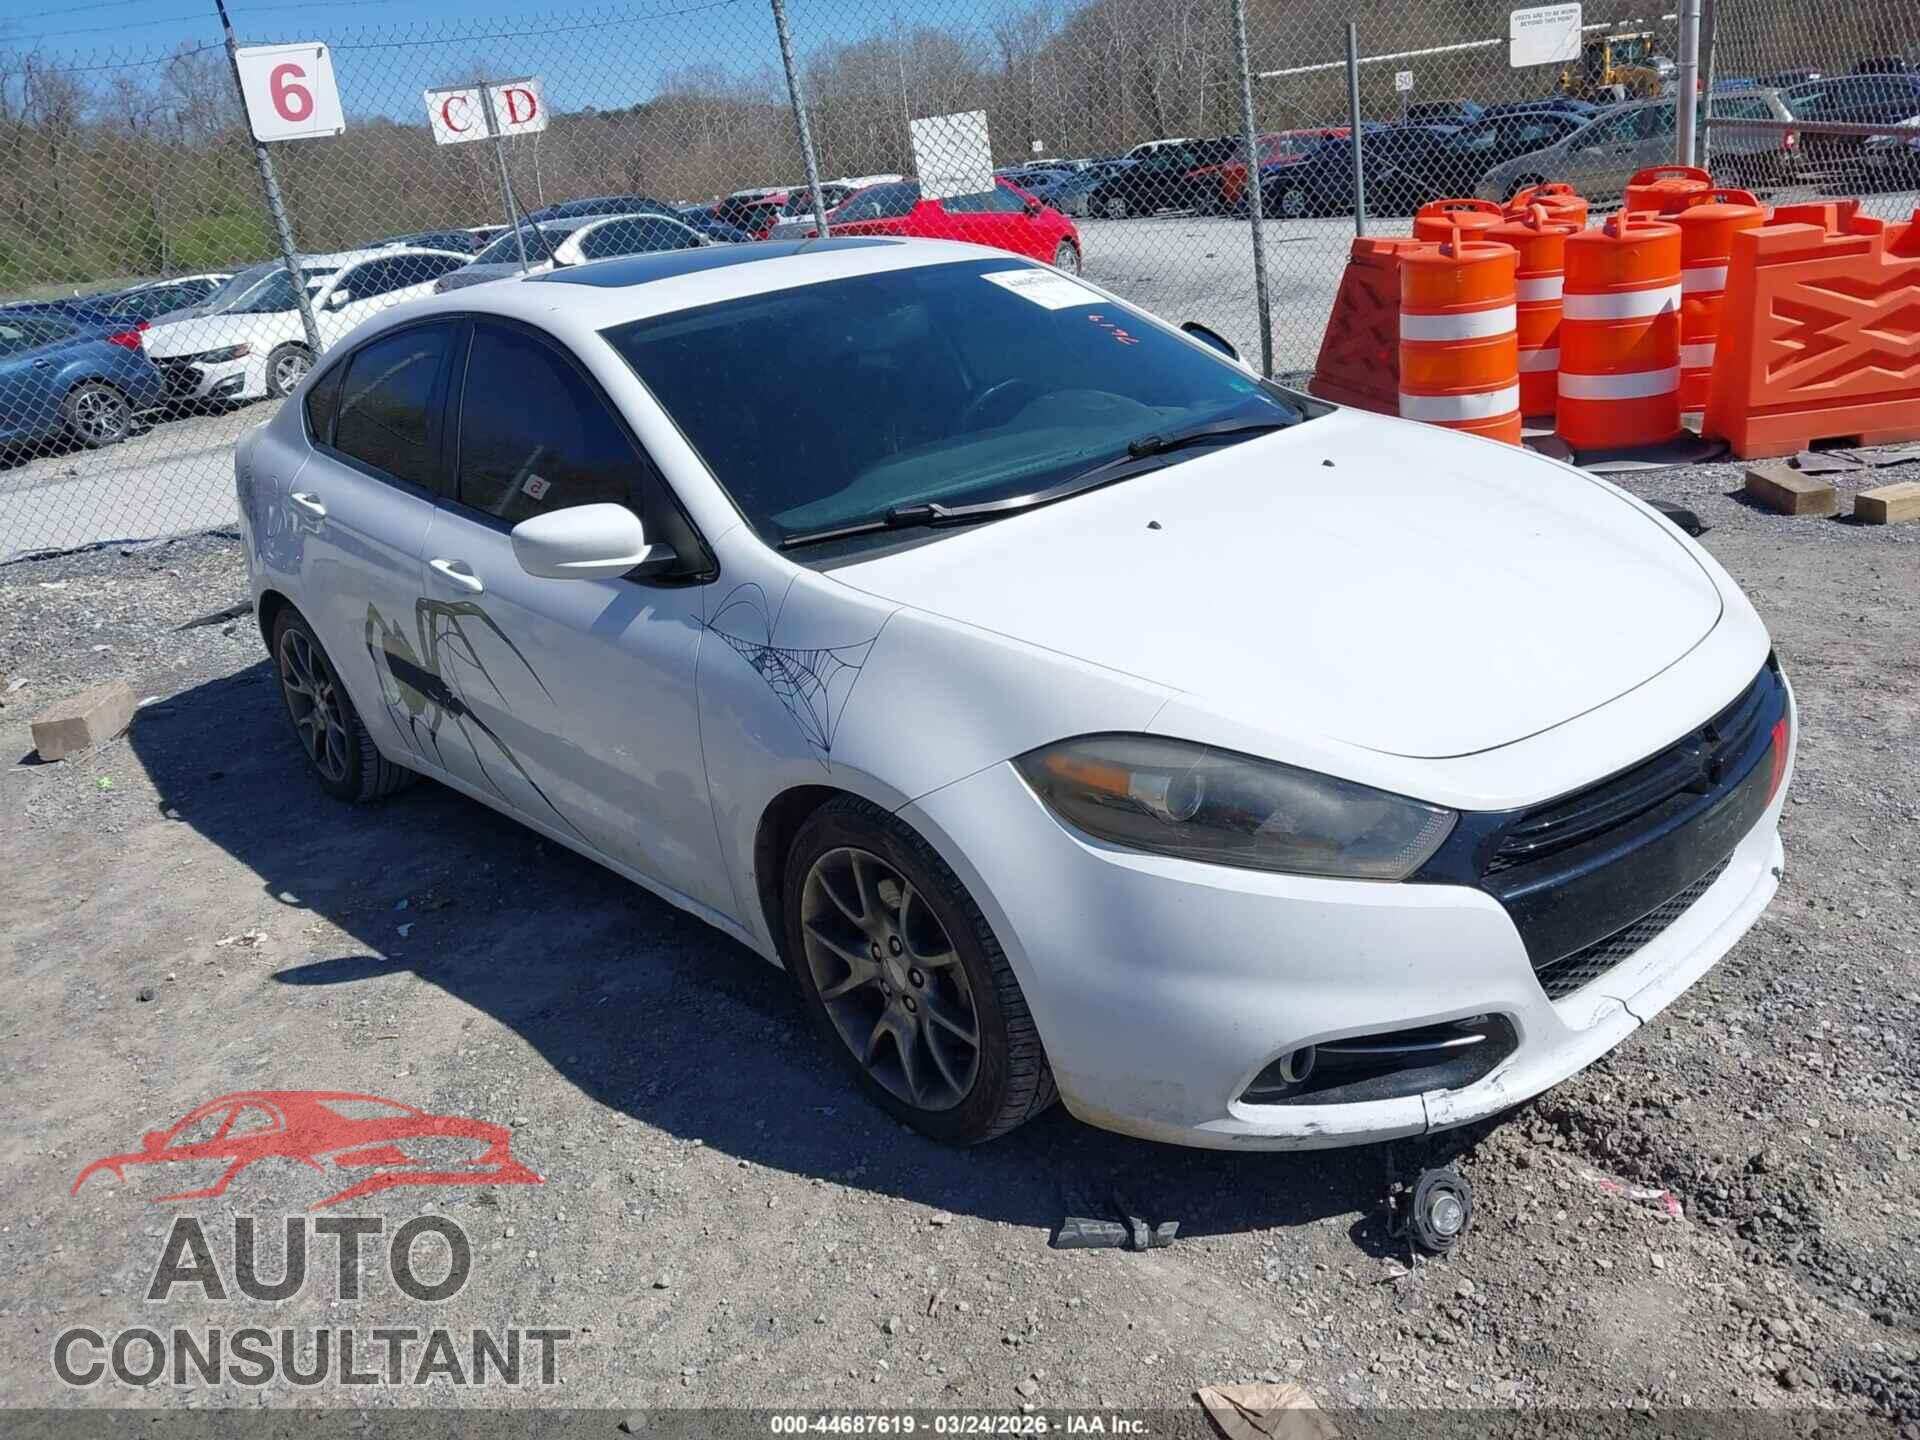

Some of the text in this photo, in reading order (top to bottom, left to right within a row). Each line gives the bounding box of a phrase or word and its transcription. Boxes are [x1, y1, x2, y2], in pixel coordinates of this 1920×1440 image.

[269, 63, 314, 122] 6
[503, 87, 537, 125] D
[441, 95, 473, 133] C
